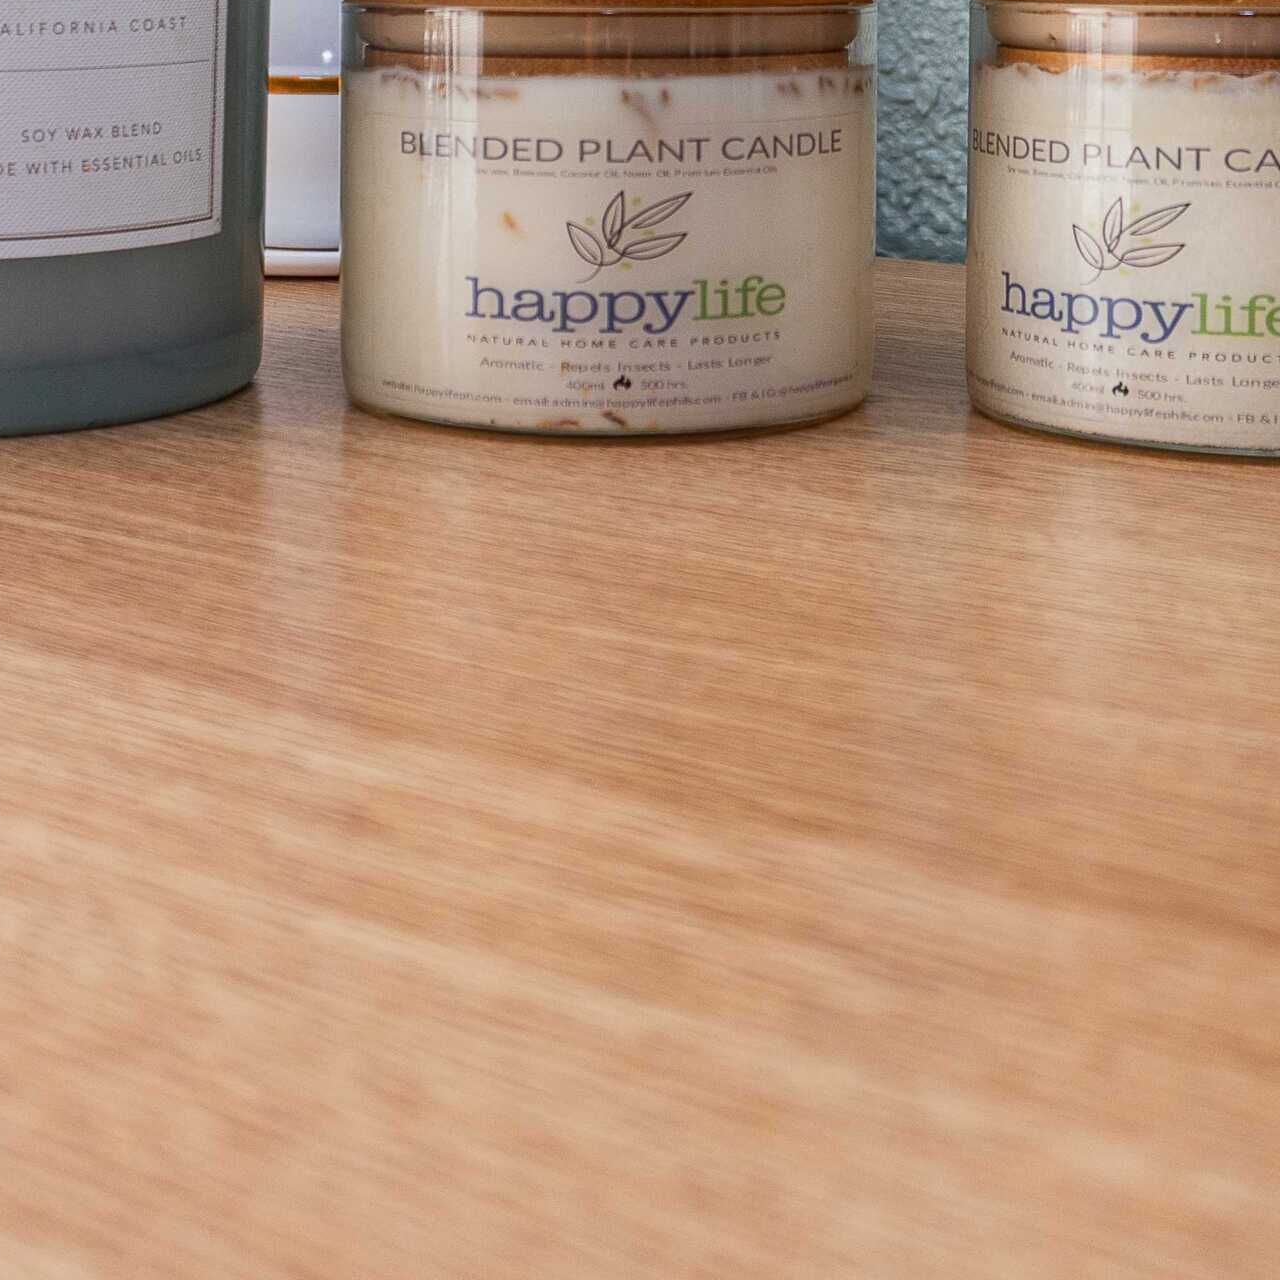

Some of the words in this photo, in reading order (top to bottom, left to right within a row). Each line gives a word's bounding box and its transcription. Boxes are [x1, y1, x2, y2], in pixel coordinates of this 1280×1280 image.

[128, 17, 187, 32] COAST
[20, 129, 57, 144] SOY
[65, 126, 104, 140] WAX
[111, 121, 162, 138] BLEND
[399, 131, 563, 164] BLENDED
[578, 136, 711, 164] PLANT
[721, 128, 843, 160] CANDLE
[25, 158, 73, 175] WITH
[81, 152, 167, 173] ESSENTIAL
[172, 148, 203, 165] OILS
[972, 127, 1070, 165] BLENDED
[1082, 142, 1210, 172] PLANT
[463, 273, 786, 336] happylife
[466, 334, 550, 349] NATURAL
[560, 338, 618, 350] HOME
[629, 337, 678, 349] CARE
[690, 330, 782, 347] PRODUCTS
[1000, 328, 1059, 348] NATURAL
[1066, 339, 1116, 356] HOME
[1127, 347, 1176, 360] CARE
[479, 357, 544, 372] Aromatic
[560, 360, 610, 375] Repels
[618, 360, 671, 373] Insects
[686, 358, 722, 372] Lasts
[726, 354, 773, 371] Longer
[1009, 350, 1055, 372] Aromatic
[1066, 361, 1111, 380] Repels
[1115, 368, 1168, 384] Insects
[1185, 374, 1226, 387] Lasts
[1136, 388, 1162, 401] 500
